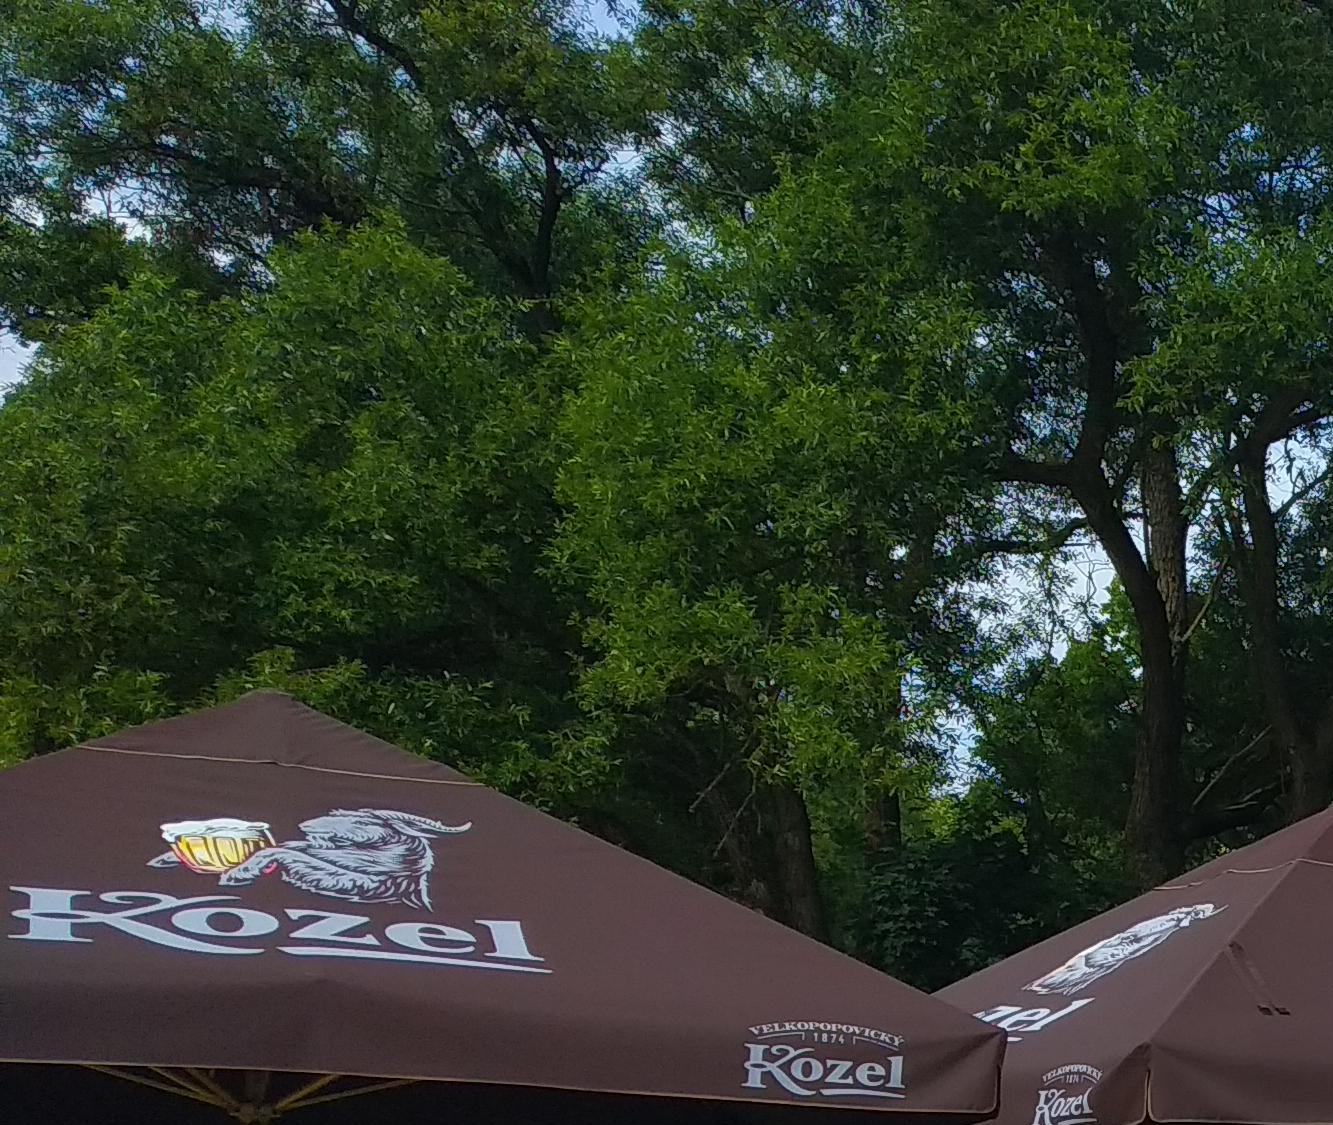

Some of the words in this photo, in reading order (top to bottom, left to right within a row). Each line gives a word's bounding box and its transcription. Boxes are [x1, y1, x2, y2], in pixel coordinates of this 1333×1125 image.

[8, 886, 549, 965] Kozel
[972, 998, 1095, 1032] zel
[748, 1021, 905, 1048] VELKOPOPOVICKÝ
[813, 1032, 844, 1044] 1874
[741, 1043, 906, 1097] Kozel
